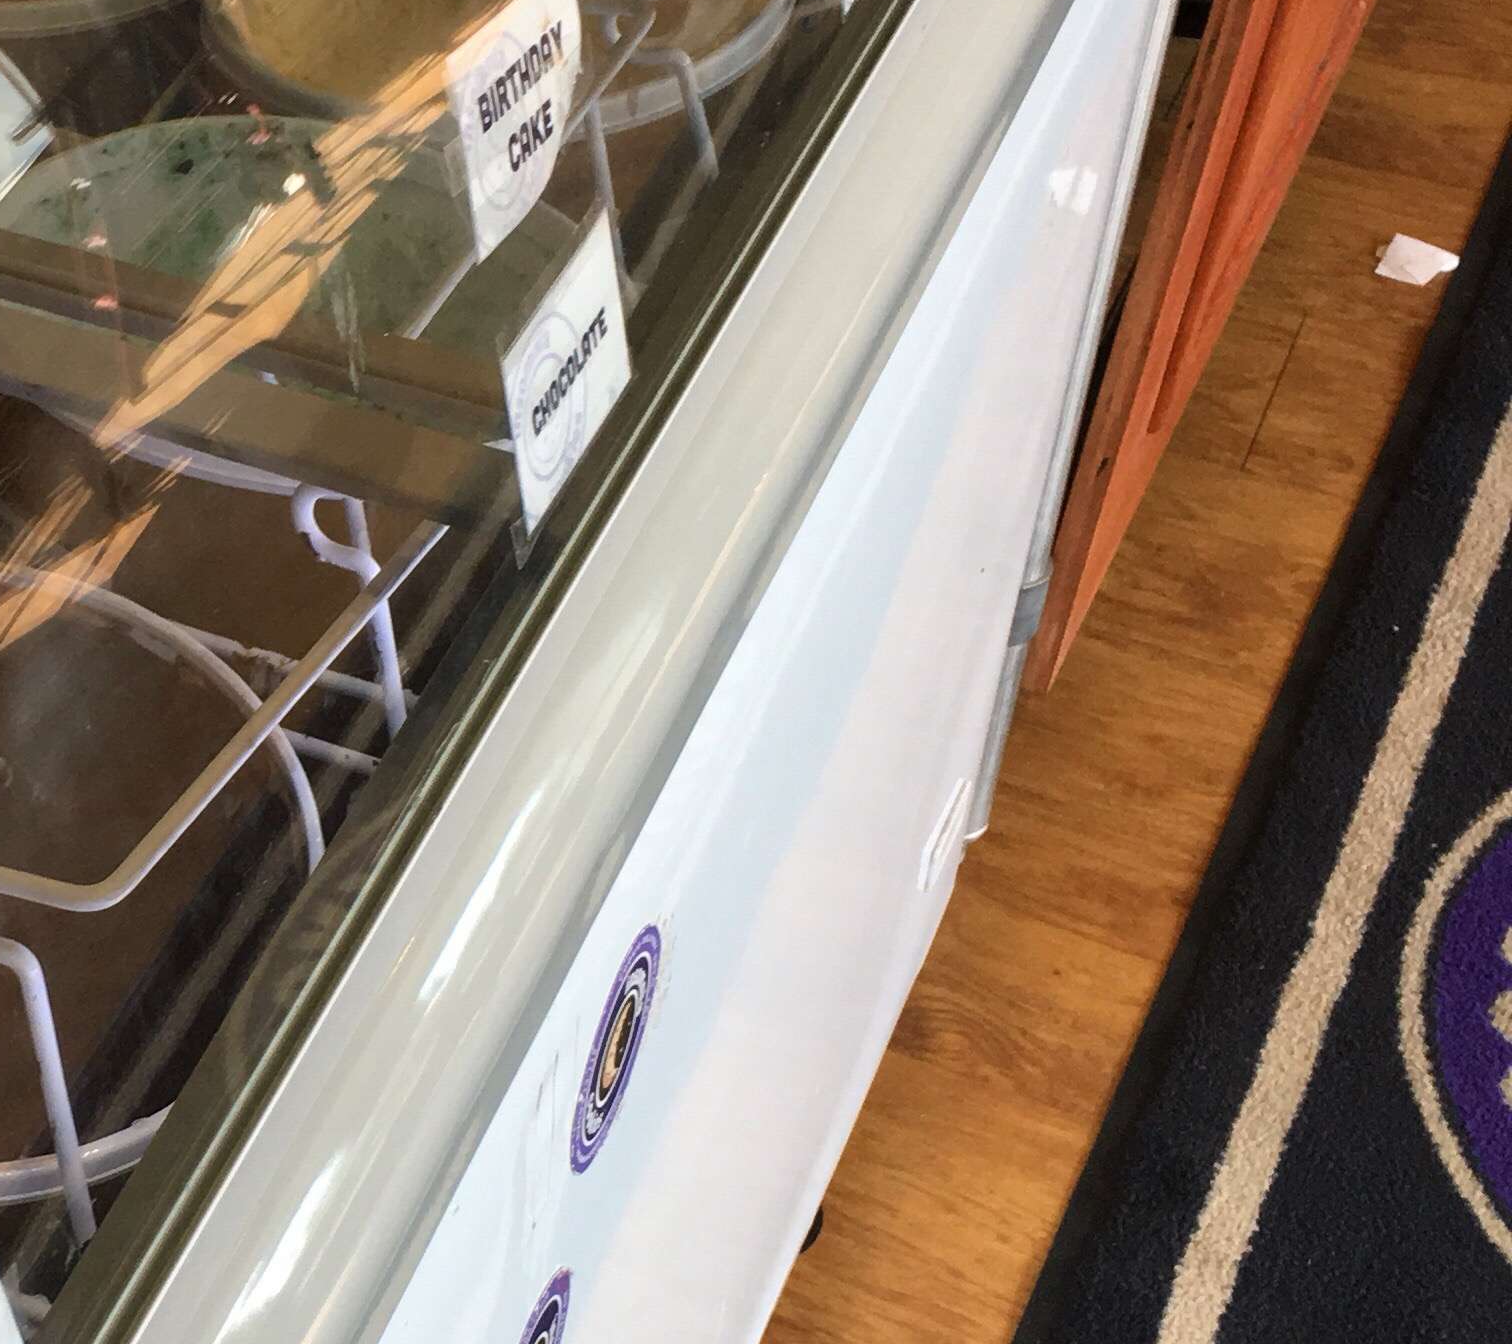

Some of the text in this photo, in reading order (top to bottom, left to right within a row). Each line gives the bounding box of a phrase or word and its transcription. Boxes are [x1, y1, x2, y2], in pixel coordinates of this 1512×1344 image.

[477, 19, 565, 134] BIRTHDAY
[507, 98, 554, 173] CAKE
[531, 306, 609, 437] CHOCOLATE
